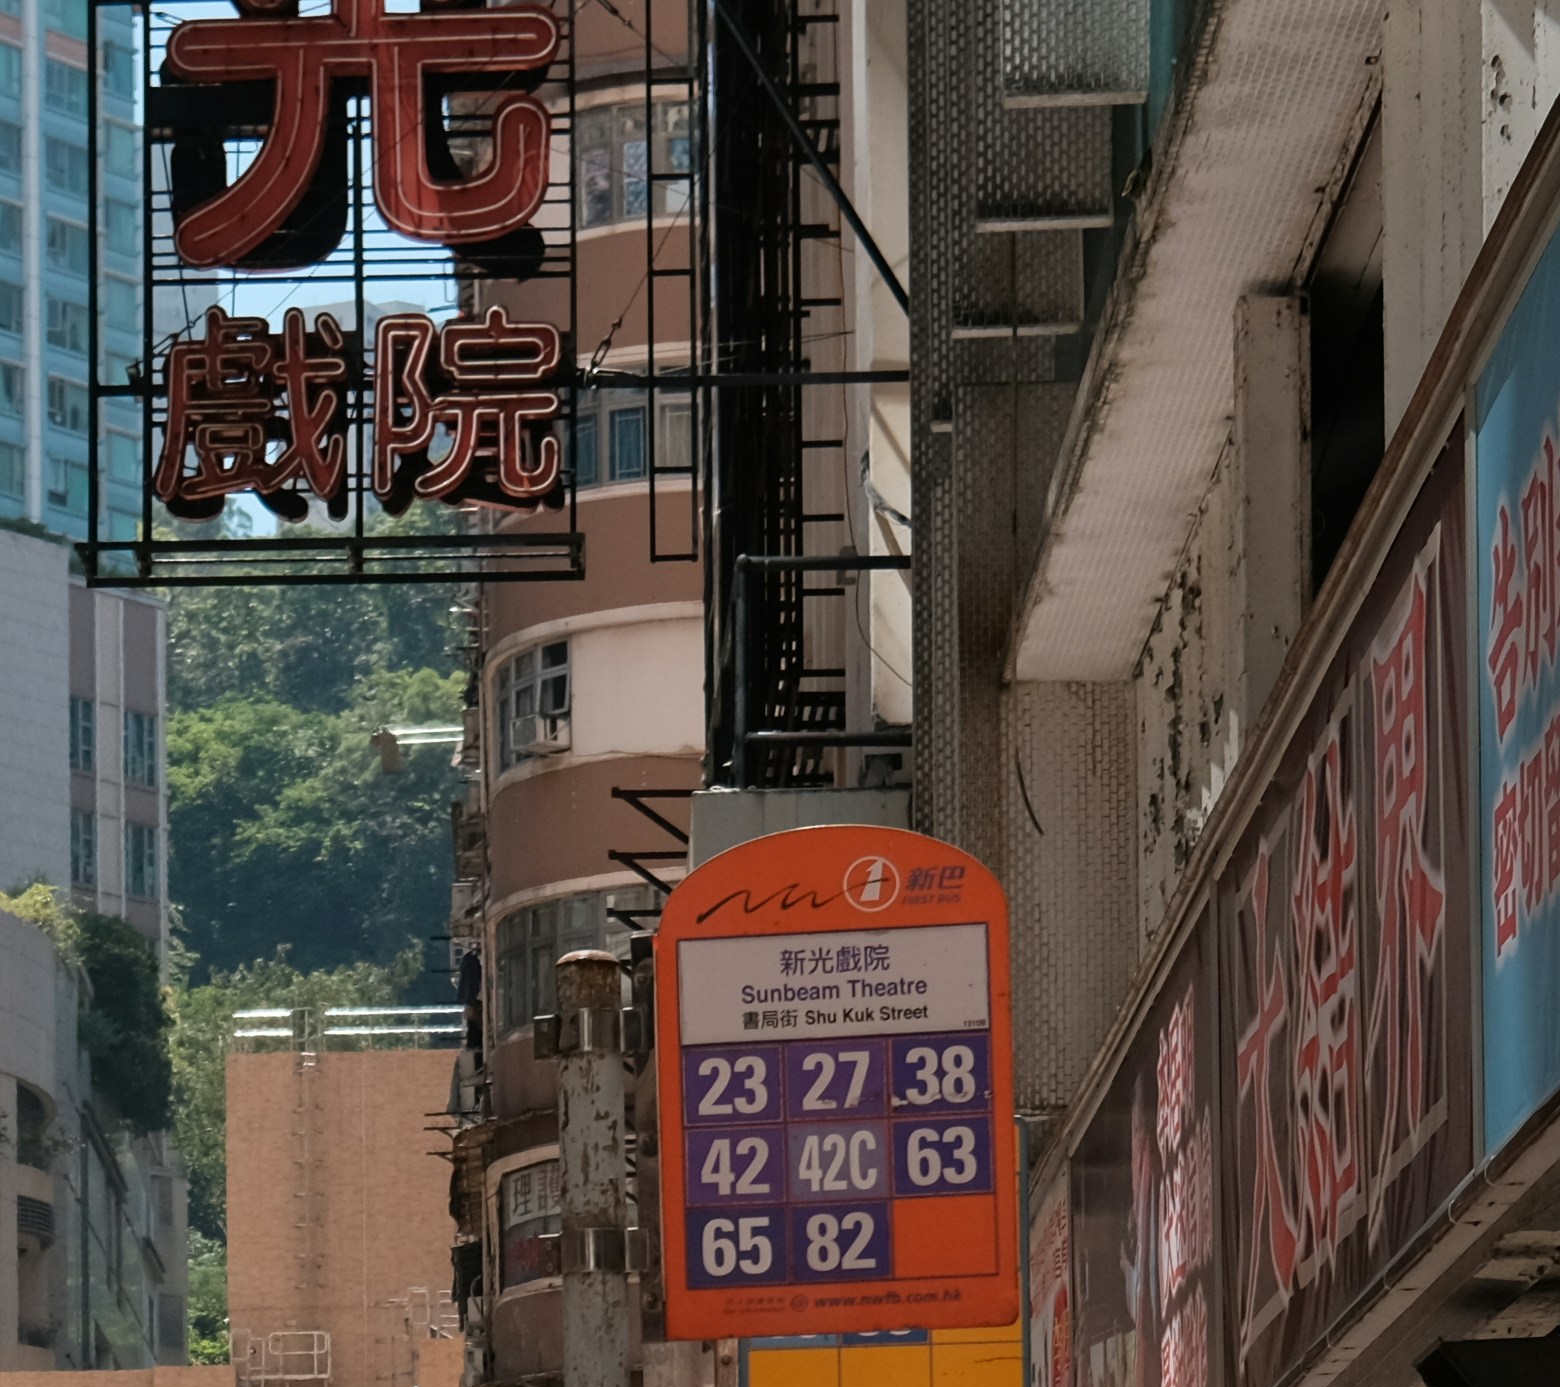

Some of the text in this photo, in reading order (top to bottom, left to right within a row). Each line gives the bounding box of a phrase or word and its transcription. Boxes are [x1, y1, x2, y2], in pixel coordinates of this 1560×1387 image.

[166, 0, 560, 272] 光
[905, 866, 966, 892] 新巴
[780, 944, 891, 977] 新光戲院
[741, 976, 928, 1005] Sunbeam Theatre
[743, 1005, 930, 1031] 書局街 Shu Kuk Street
[697, 1045, 976, 1116] 23 27 38
[700, 1125, 978, 1196] 42 42C 63
[701, 1211, 877, 1277] 65 82
